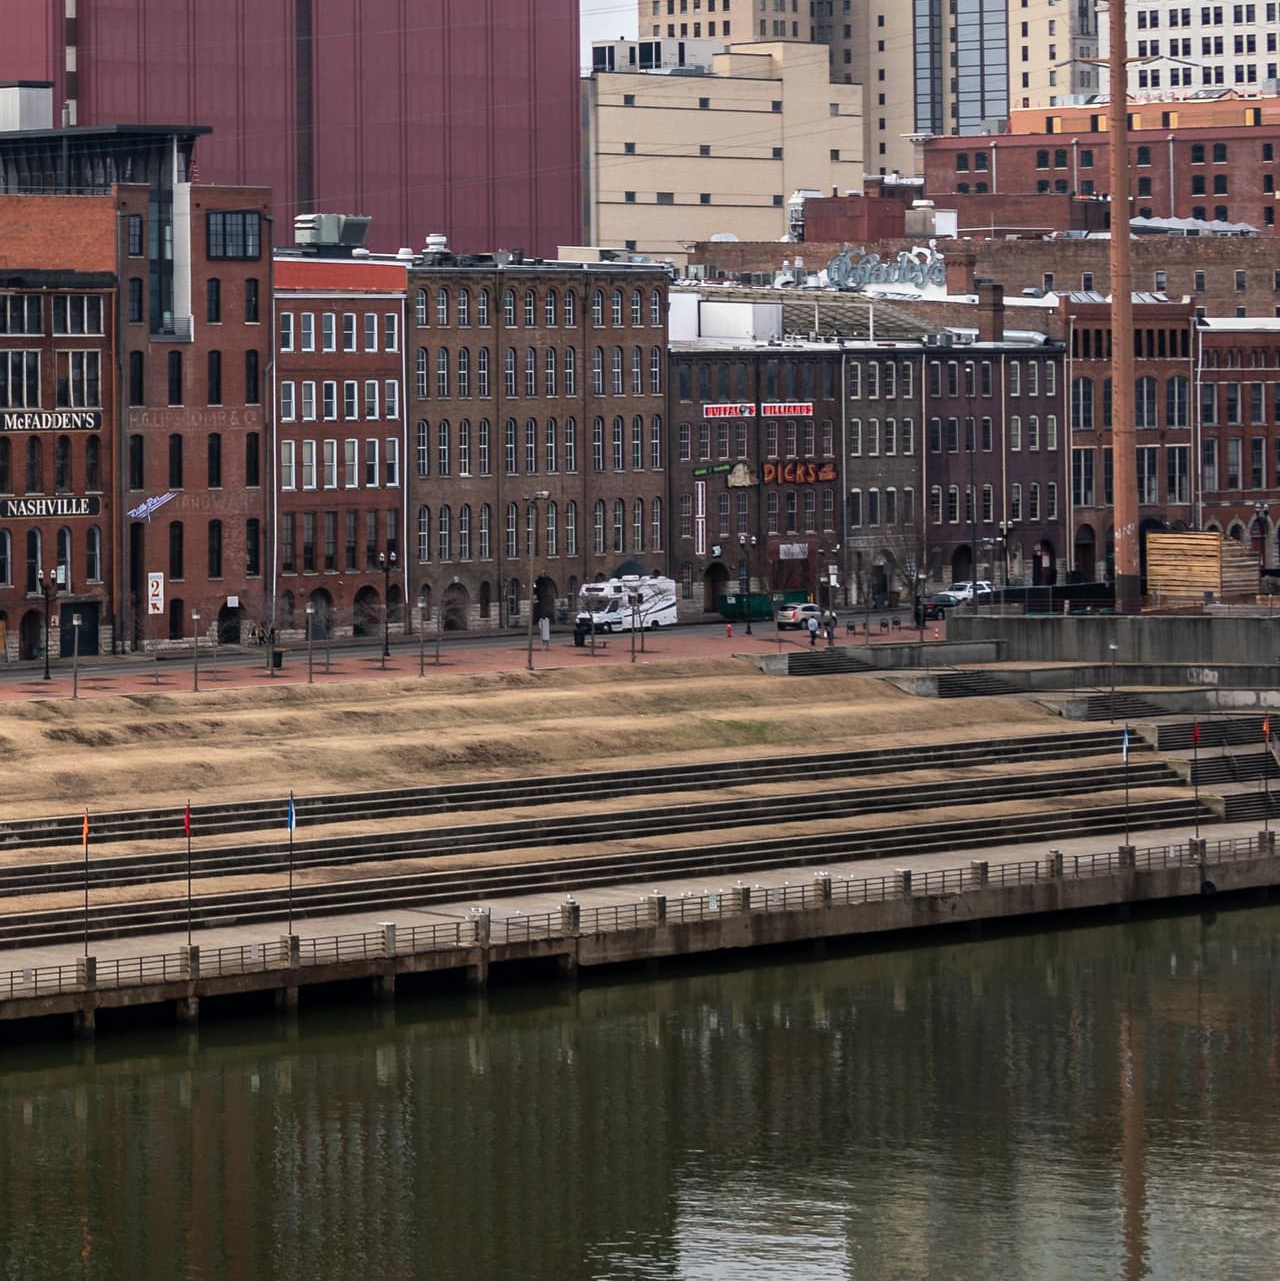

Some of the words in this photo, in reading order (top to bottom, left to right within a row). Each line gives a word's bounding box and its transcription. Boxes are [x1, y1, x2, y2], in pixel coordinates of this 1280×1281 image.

[4, 412, 95, 430] McFADDEN'S
[7, 499, 90, 516] NASHVILLE
[151, 580, 160, 598] 2
